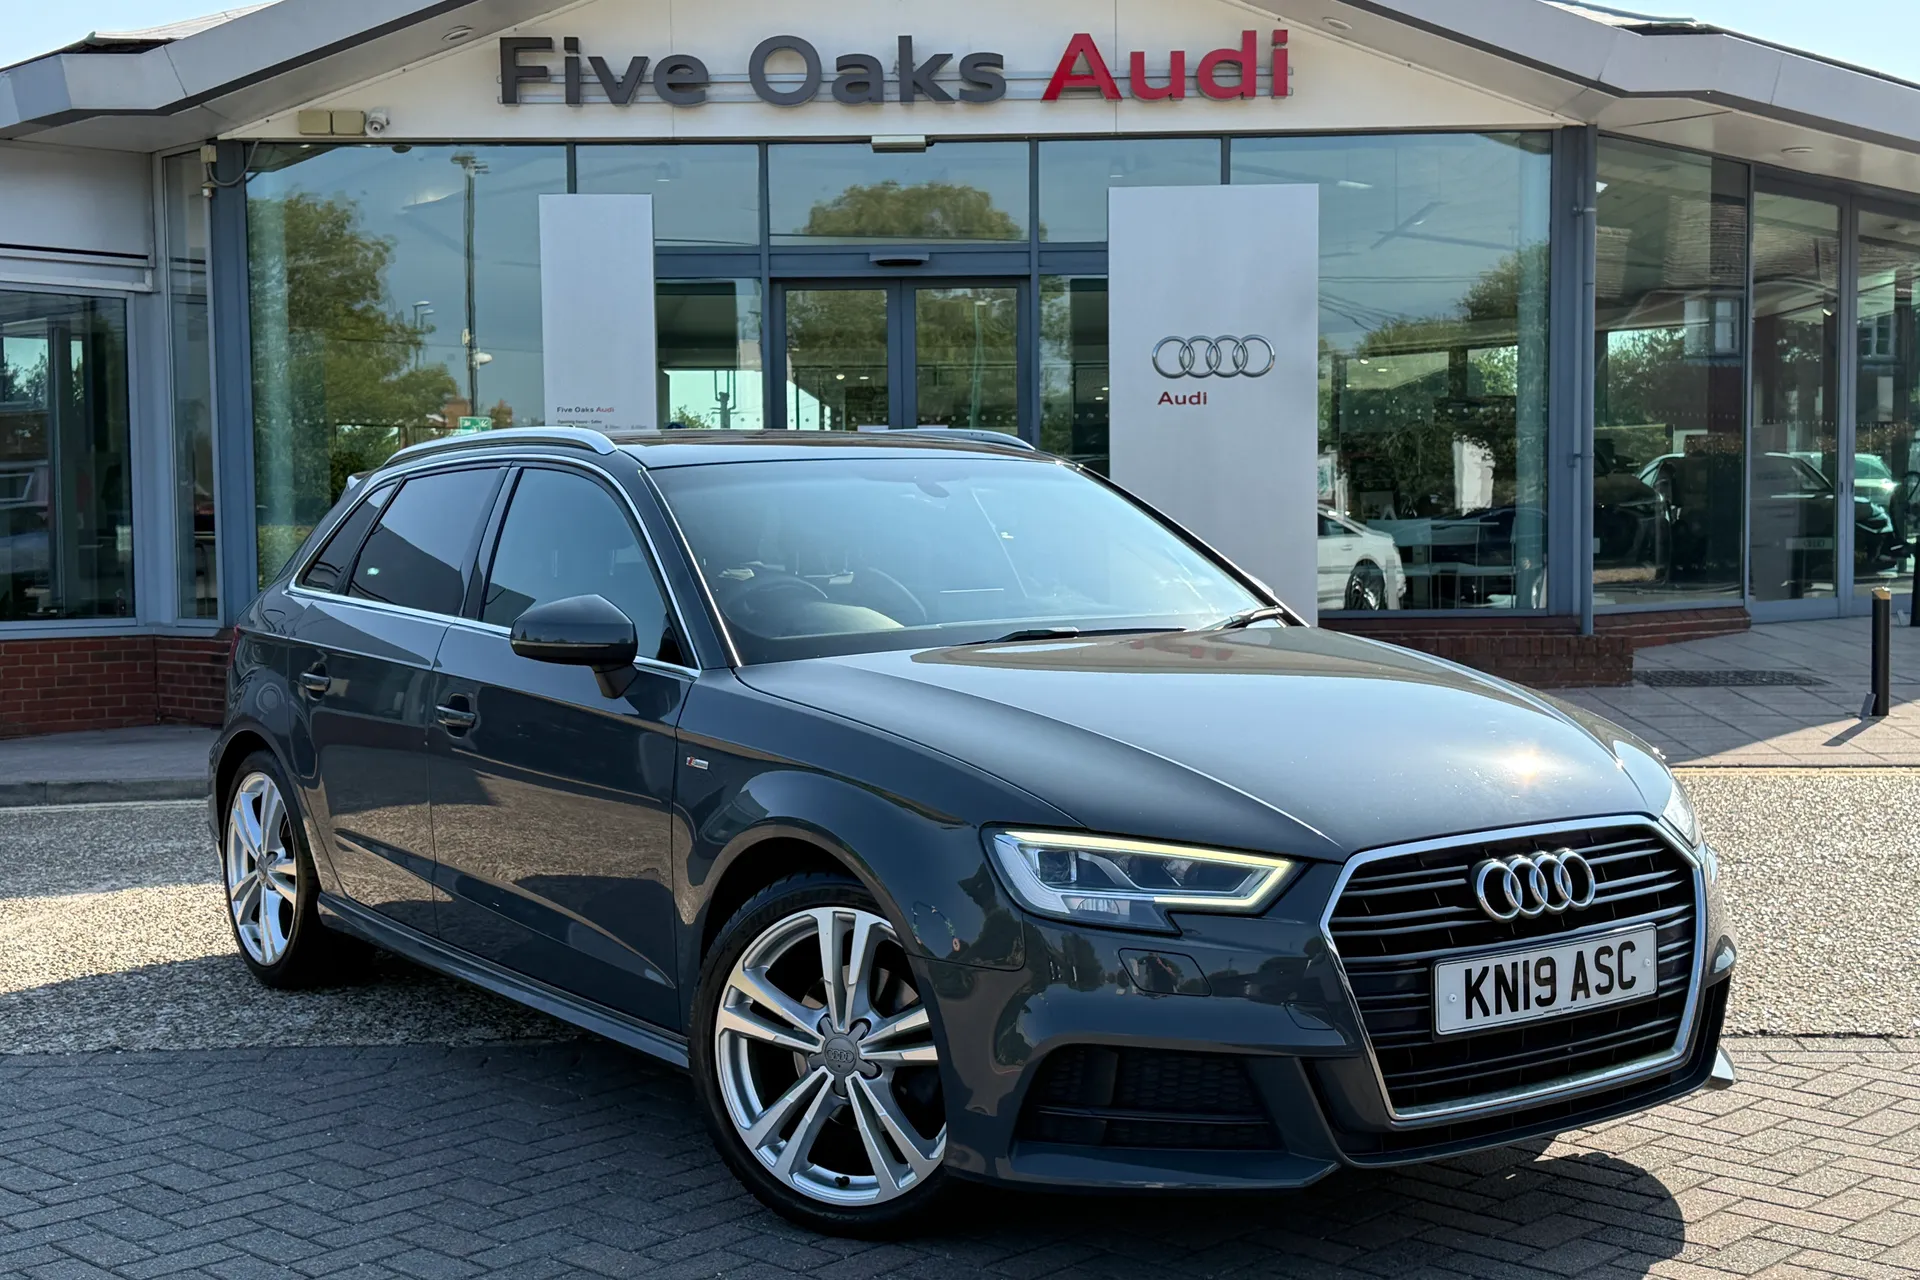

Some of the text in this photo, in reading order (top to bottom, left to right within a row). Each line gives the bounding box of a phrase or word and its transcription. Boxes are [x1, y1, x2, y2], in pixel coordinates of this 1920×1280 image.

[499, 29, 1289, 107] Five Oaks Audi
[1157, 390, 1208, 406] Audi
[1464, 940, 1636, 1020] KN19 ASC
